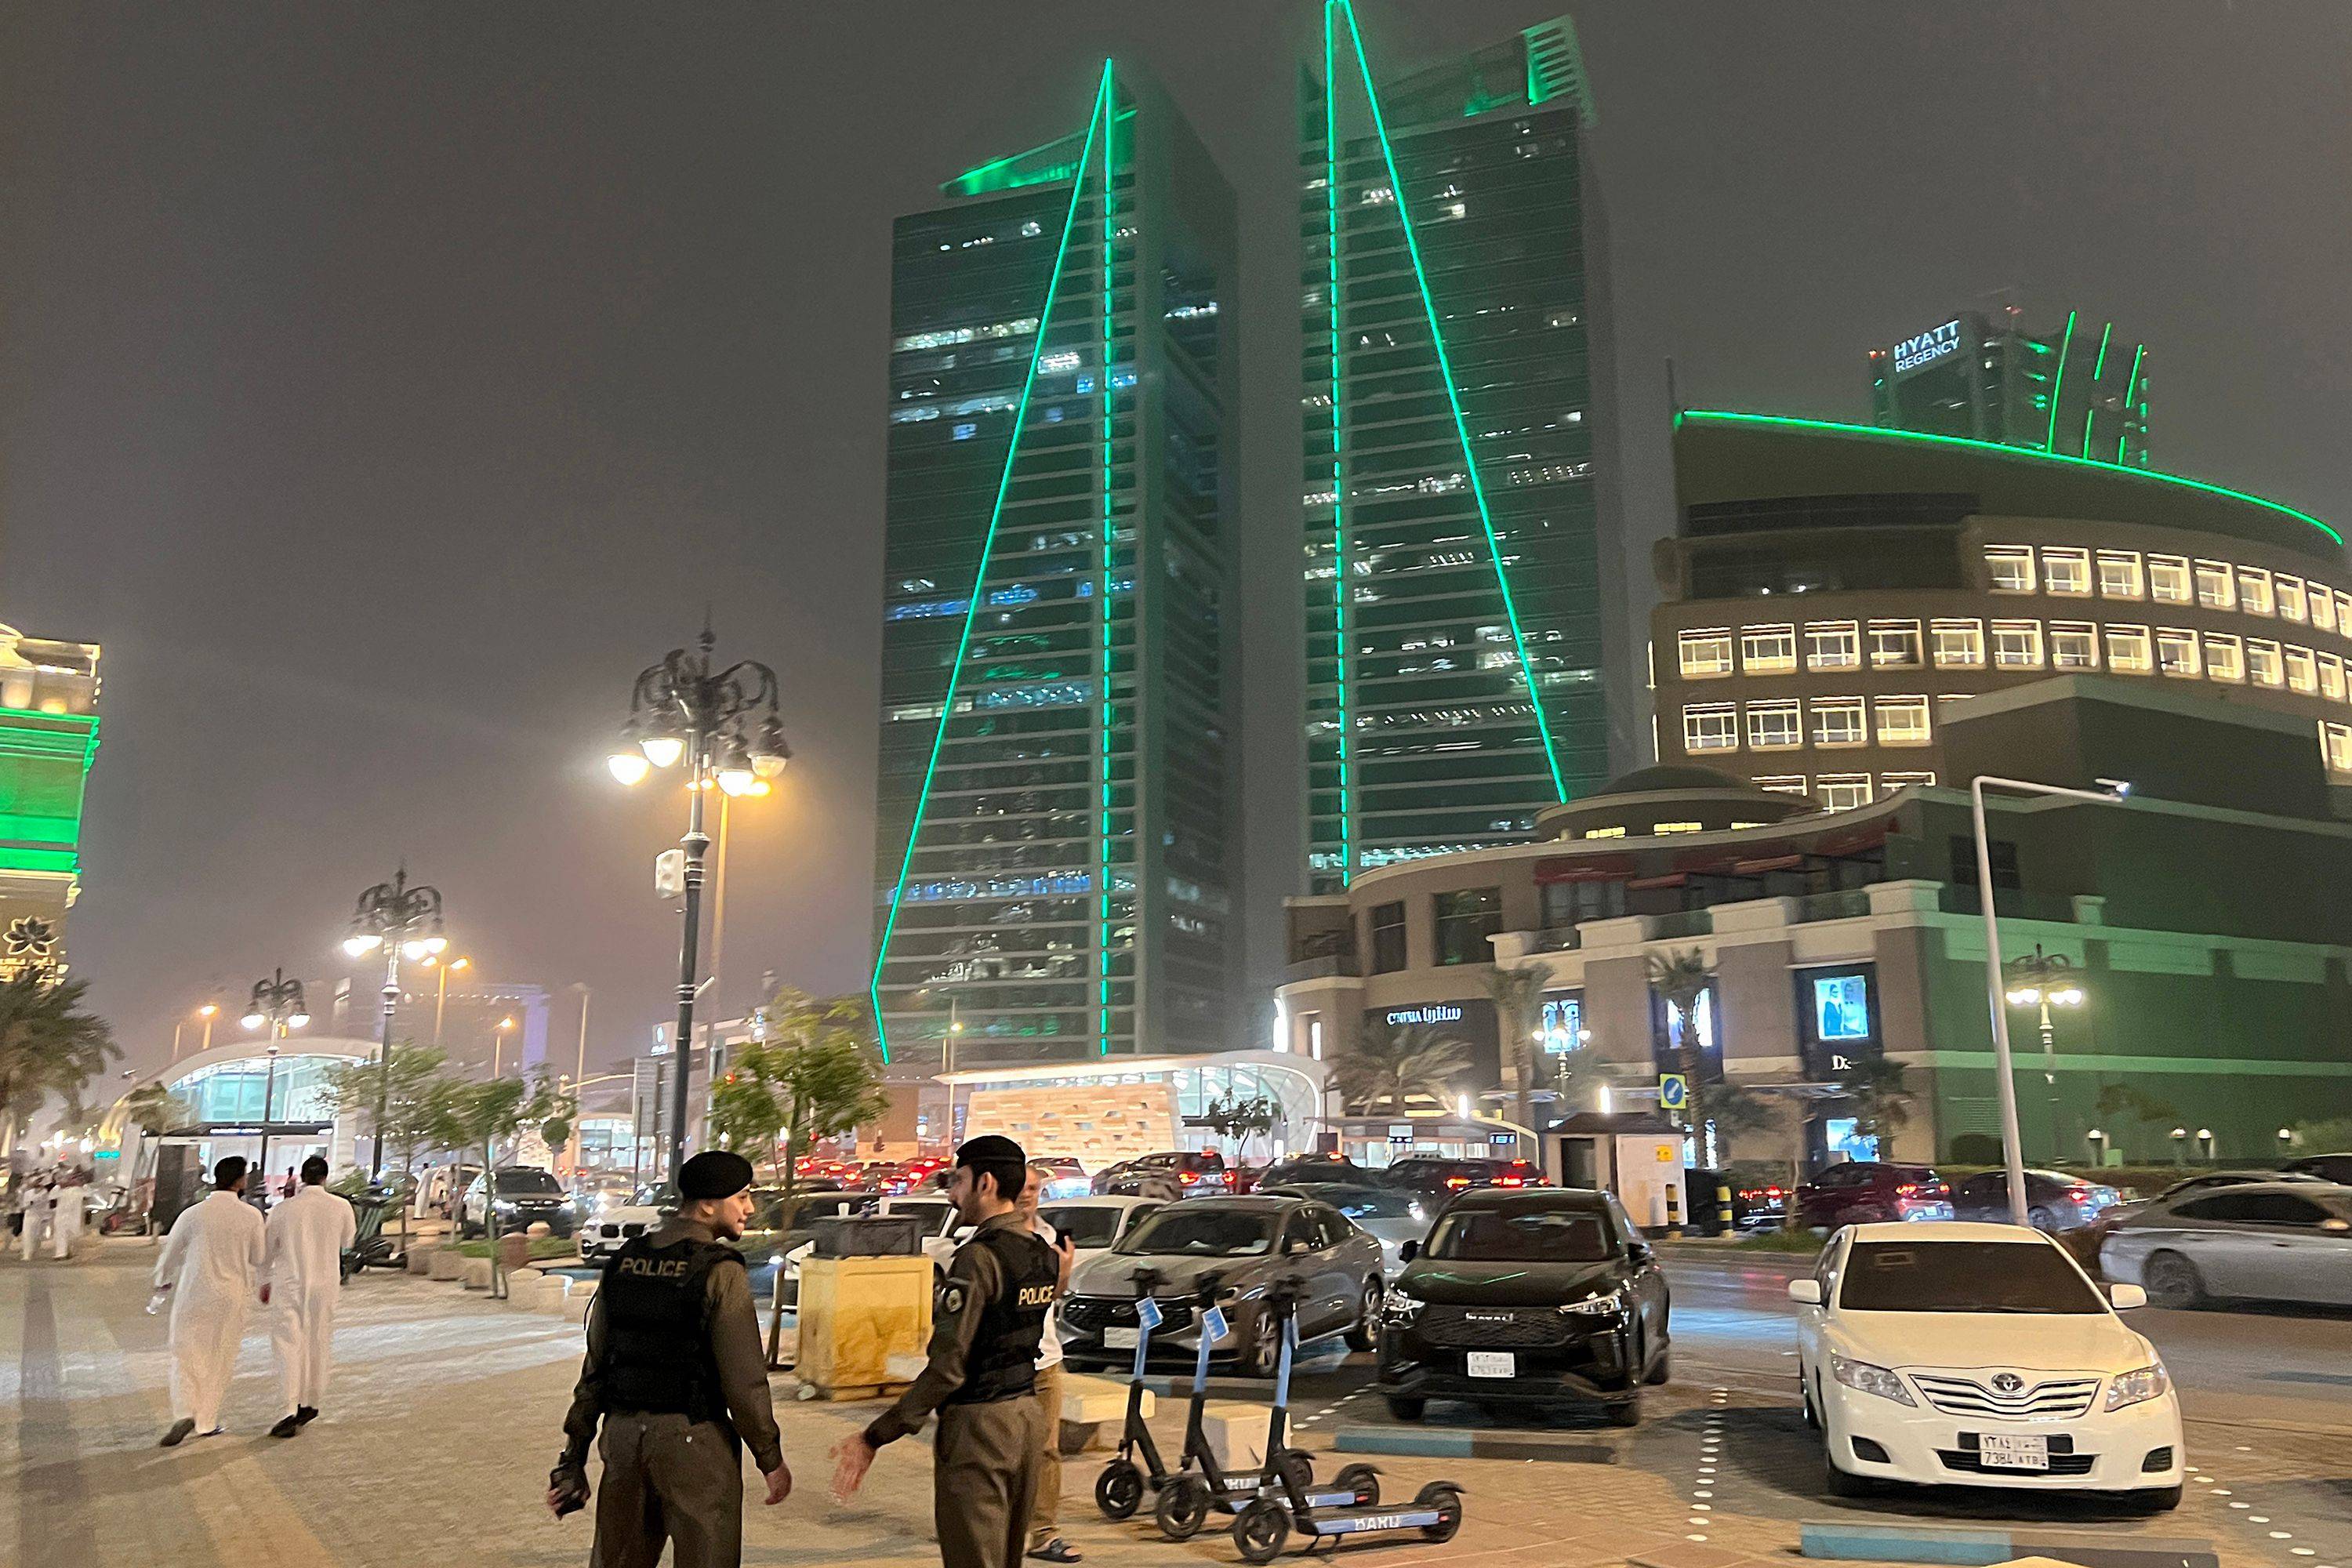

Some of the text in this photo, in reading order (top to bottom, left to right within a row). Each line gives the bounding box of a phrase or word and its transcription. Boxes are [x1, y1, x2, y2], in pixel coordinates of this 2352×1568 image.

[1894, 319, 1960, 359] HYATT
[1895, 336, 1960, 372] REGENCY
[619, 1257, 688, 1278] POLICE
[1018, 1284, 1055, 1306] POLICE
